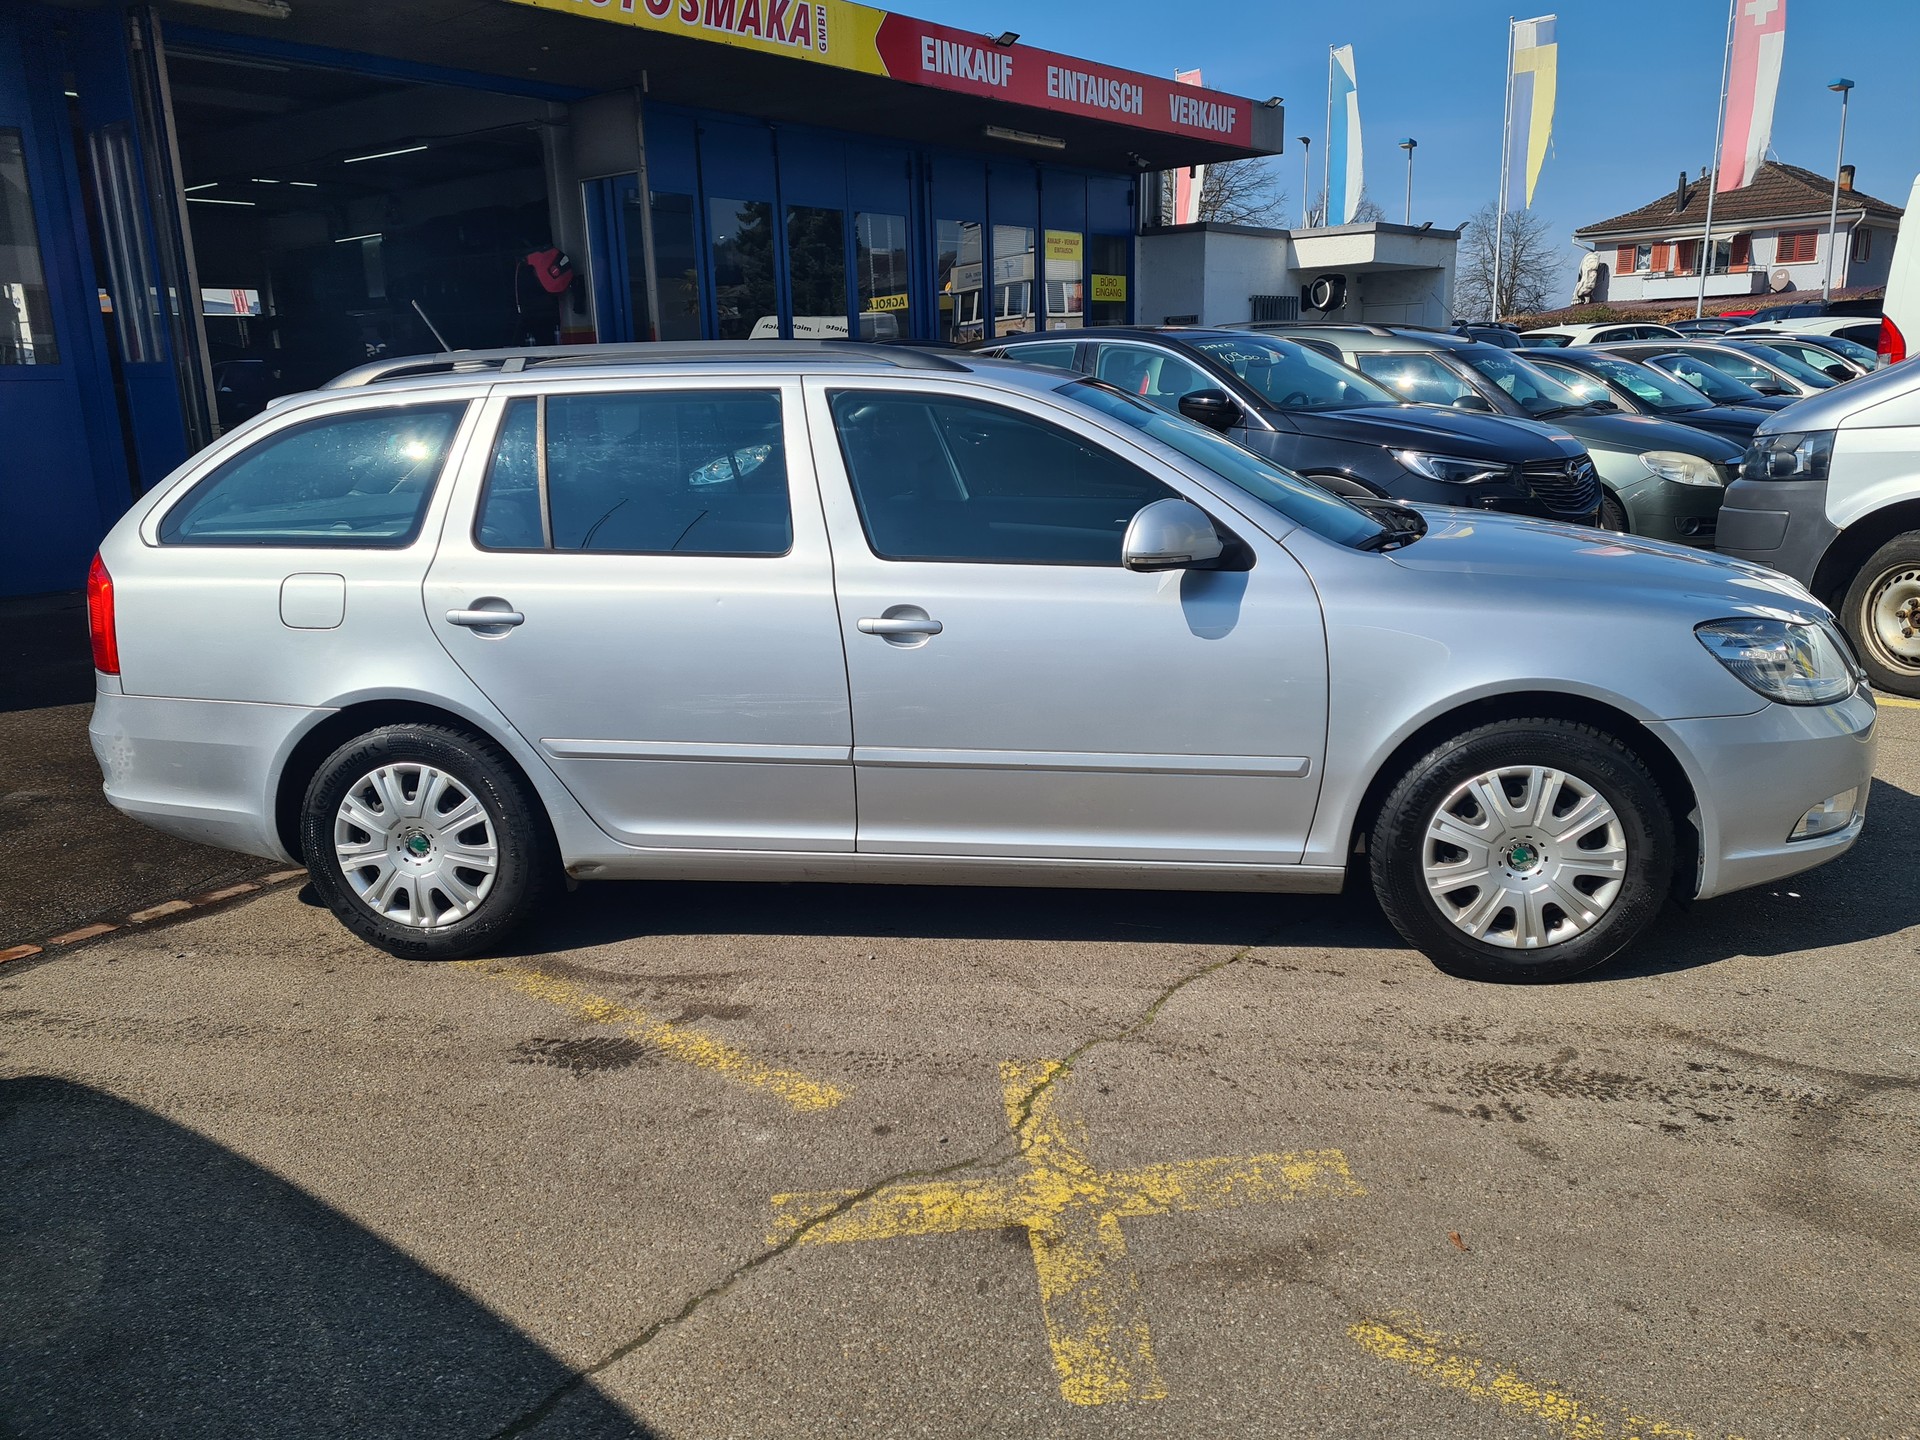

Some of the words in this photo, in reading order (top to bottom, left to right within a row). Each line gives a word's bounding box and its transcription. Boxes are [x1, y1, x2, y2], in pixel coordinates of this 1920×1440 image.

[576, 0, 812, 48] SMAKA
[817, 6, 827, 52] GMBH
[921, 35, 1013, 87] EINKAUF
[1047, 65, 1143, 115] EINTAUSCH
[1169, 93, 1236, 133] VERKAUF
[1095, 287, 1122, 297] EINGANG
[1100, 277, 1118, 287] BÜRO
